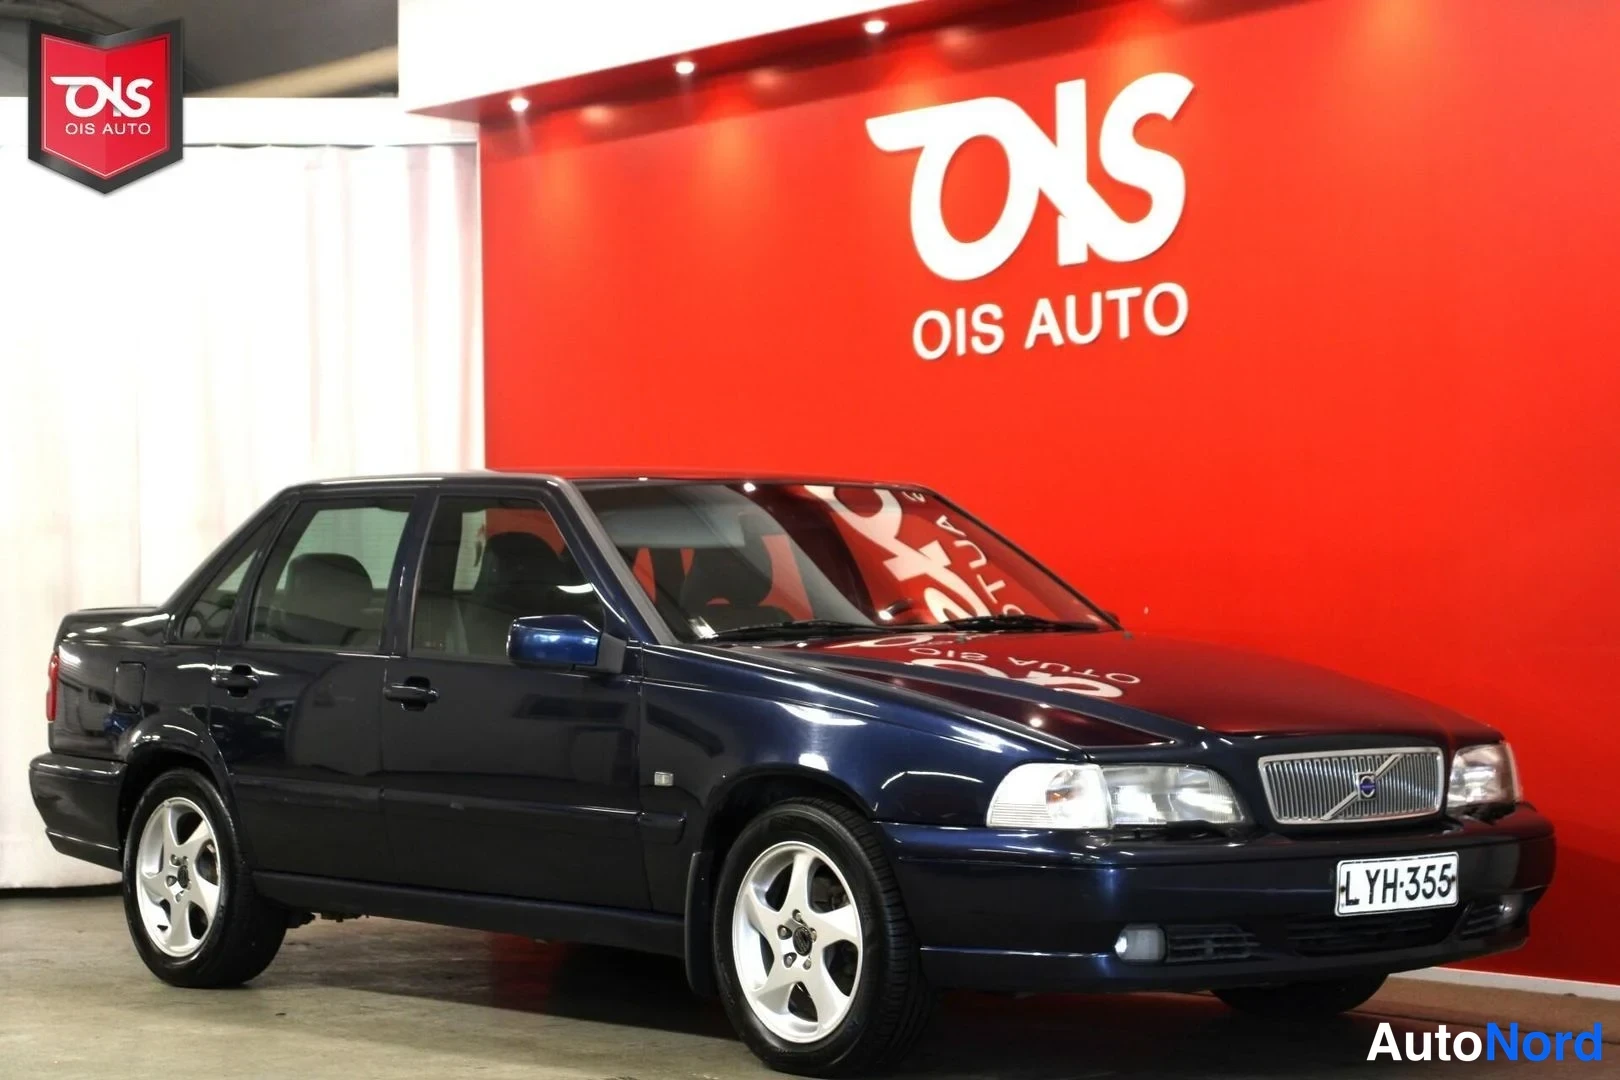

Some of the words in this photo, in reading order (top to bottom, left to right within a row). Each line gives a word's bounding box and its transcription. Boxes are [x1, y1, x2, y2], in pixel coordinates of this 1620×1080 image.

[865, 72, 1194, 281] OIS
[912, 303, 1005, 361] OIS
[1024, 282, 1189, 350] AUTO
[1345, 863, 1453, 906] LYH-355
